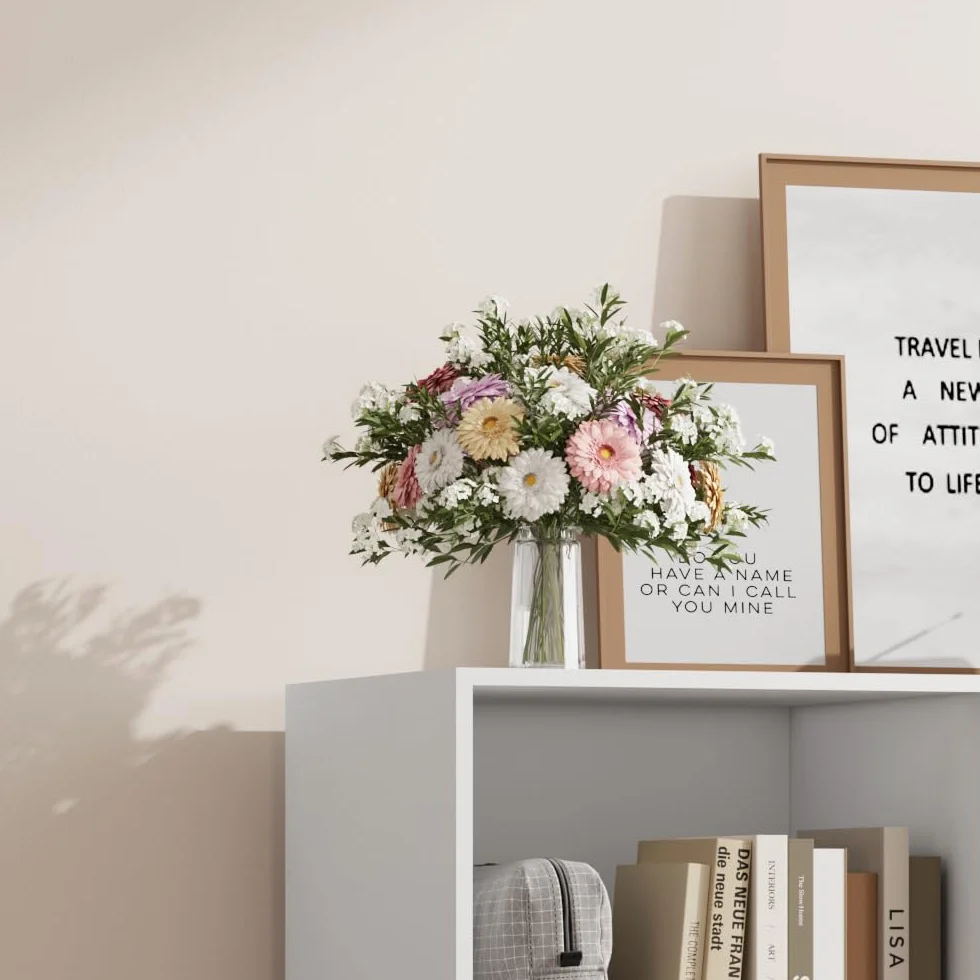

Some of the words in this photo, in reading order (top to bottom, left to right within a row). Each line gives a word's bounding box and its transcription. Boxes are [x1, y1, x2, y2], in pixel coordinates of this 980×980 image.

[894, 336, 972, 358] TRAVEL
[902, 380, 917, 400] A
[872, 422, 899, 445] OF
[905, 471, 934, 493] TO
[651, 567, 704, 581] HAVE
[713, 570, 726, 581] A
[736, 569, 793, 582] NAME
[640, 583, 668, 596] OR
[678, 584, 720, 597] CAN
[731, 585, 735, 597] I
[745, 586, 797, 599] CALL
[671, 600, 713, 613] YOU
[724, 602, 773, 615] MINE
[716, 846, 731, 868] die
[735, 848, 751, 882] DAS
[714, 873, 726, 909] neue
[767, 860, 776, 910] INTERIORS
[731, 886, 747, 930] NEUE
[710, 913, 724, 951] stadt
[889, 909, 905, 968] LISA
